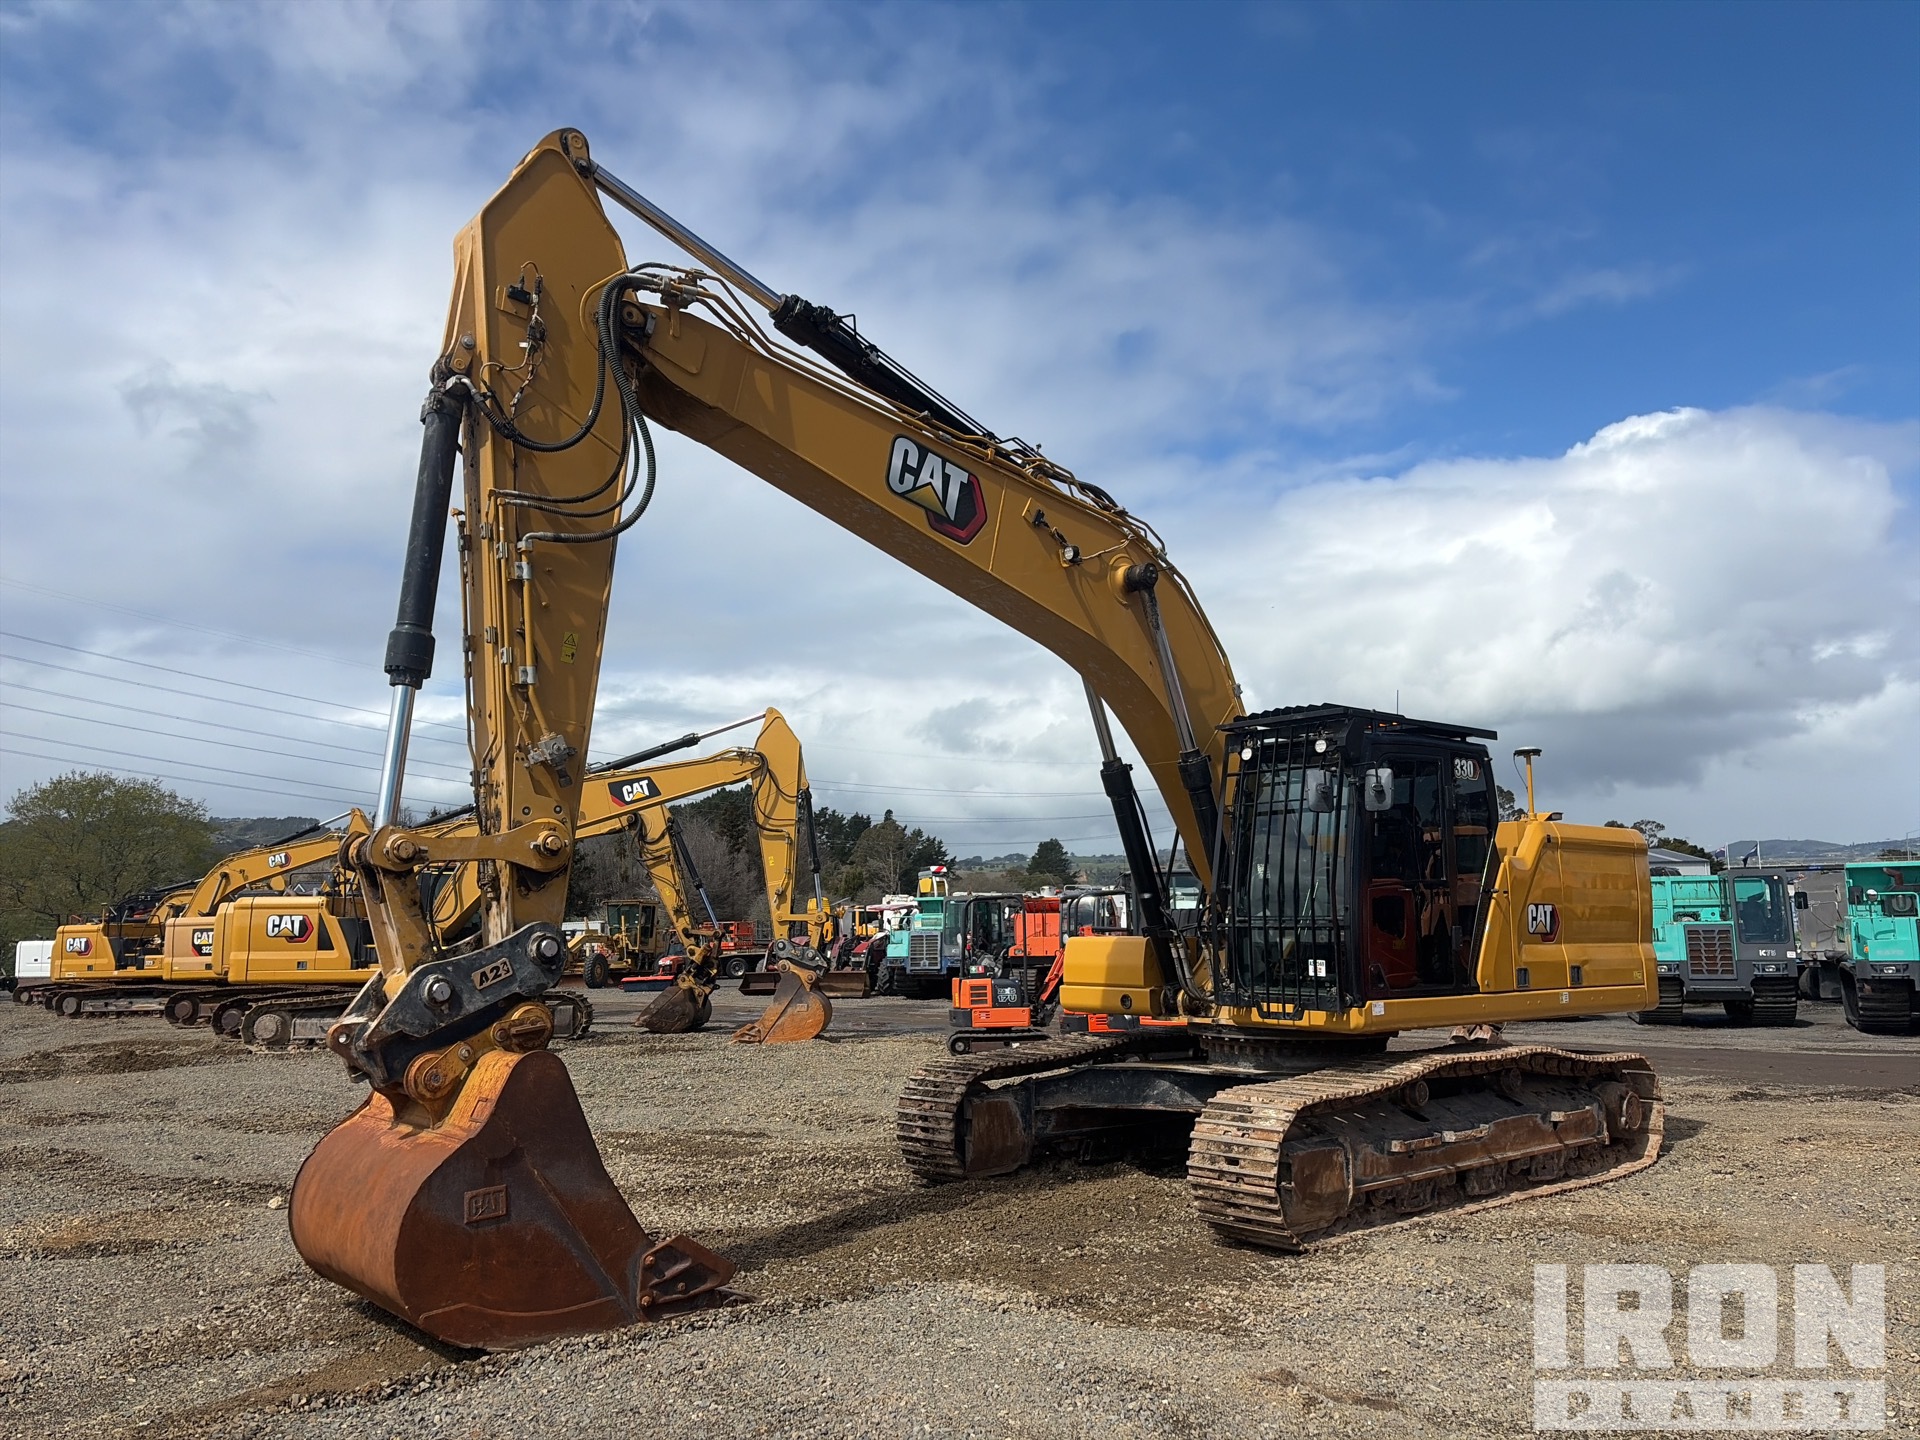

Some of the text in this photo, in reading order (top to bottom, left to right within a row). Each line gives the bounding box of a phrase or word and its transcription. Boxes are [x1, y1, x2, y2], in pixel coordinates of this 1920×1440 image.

[888, 437, 969, 521] CAT
[1454, 758, 1474, 778] 330
[622, 779, 650, 802] CAT
[268, 852, 287, 868] CAT
[267, 915, 303, 937] CAT
[1527, 904, 1553, 934] CAT
[66, 937, 87, 952] CAT
[193, 931, 214, 945] CAT
